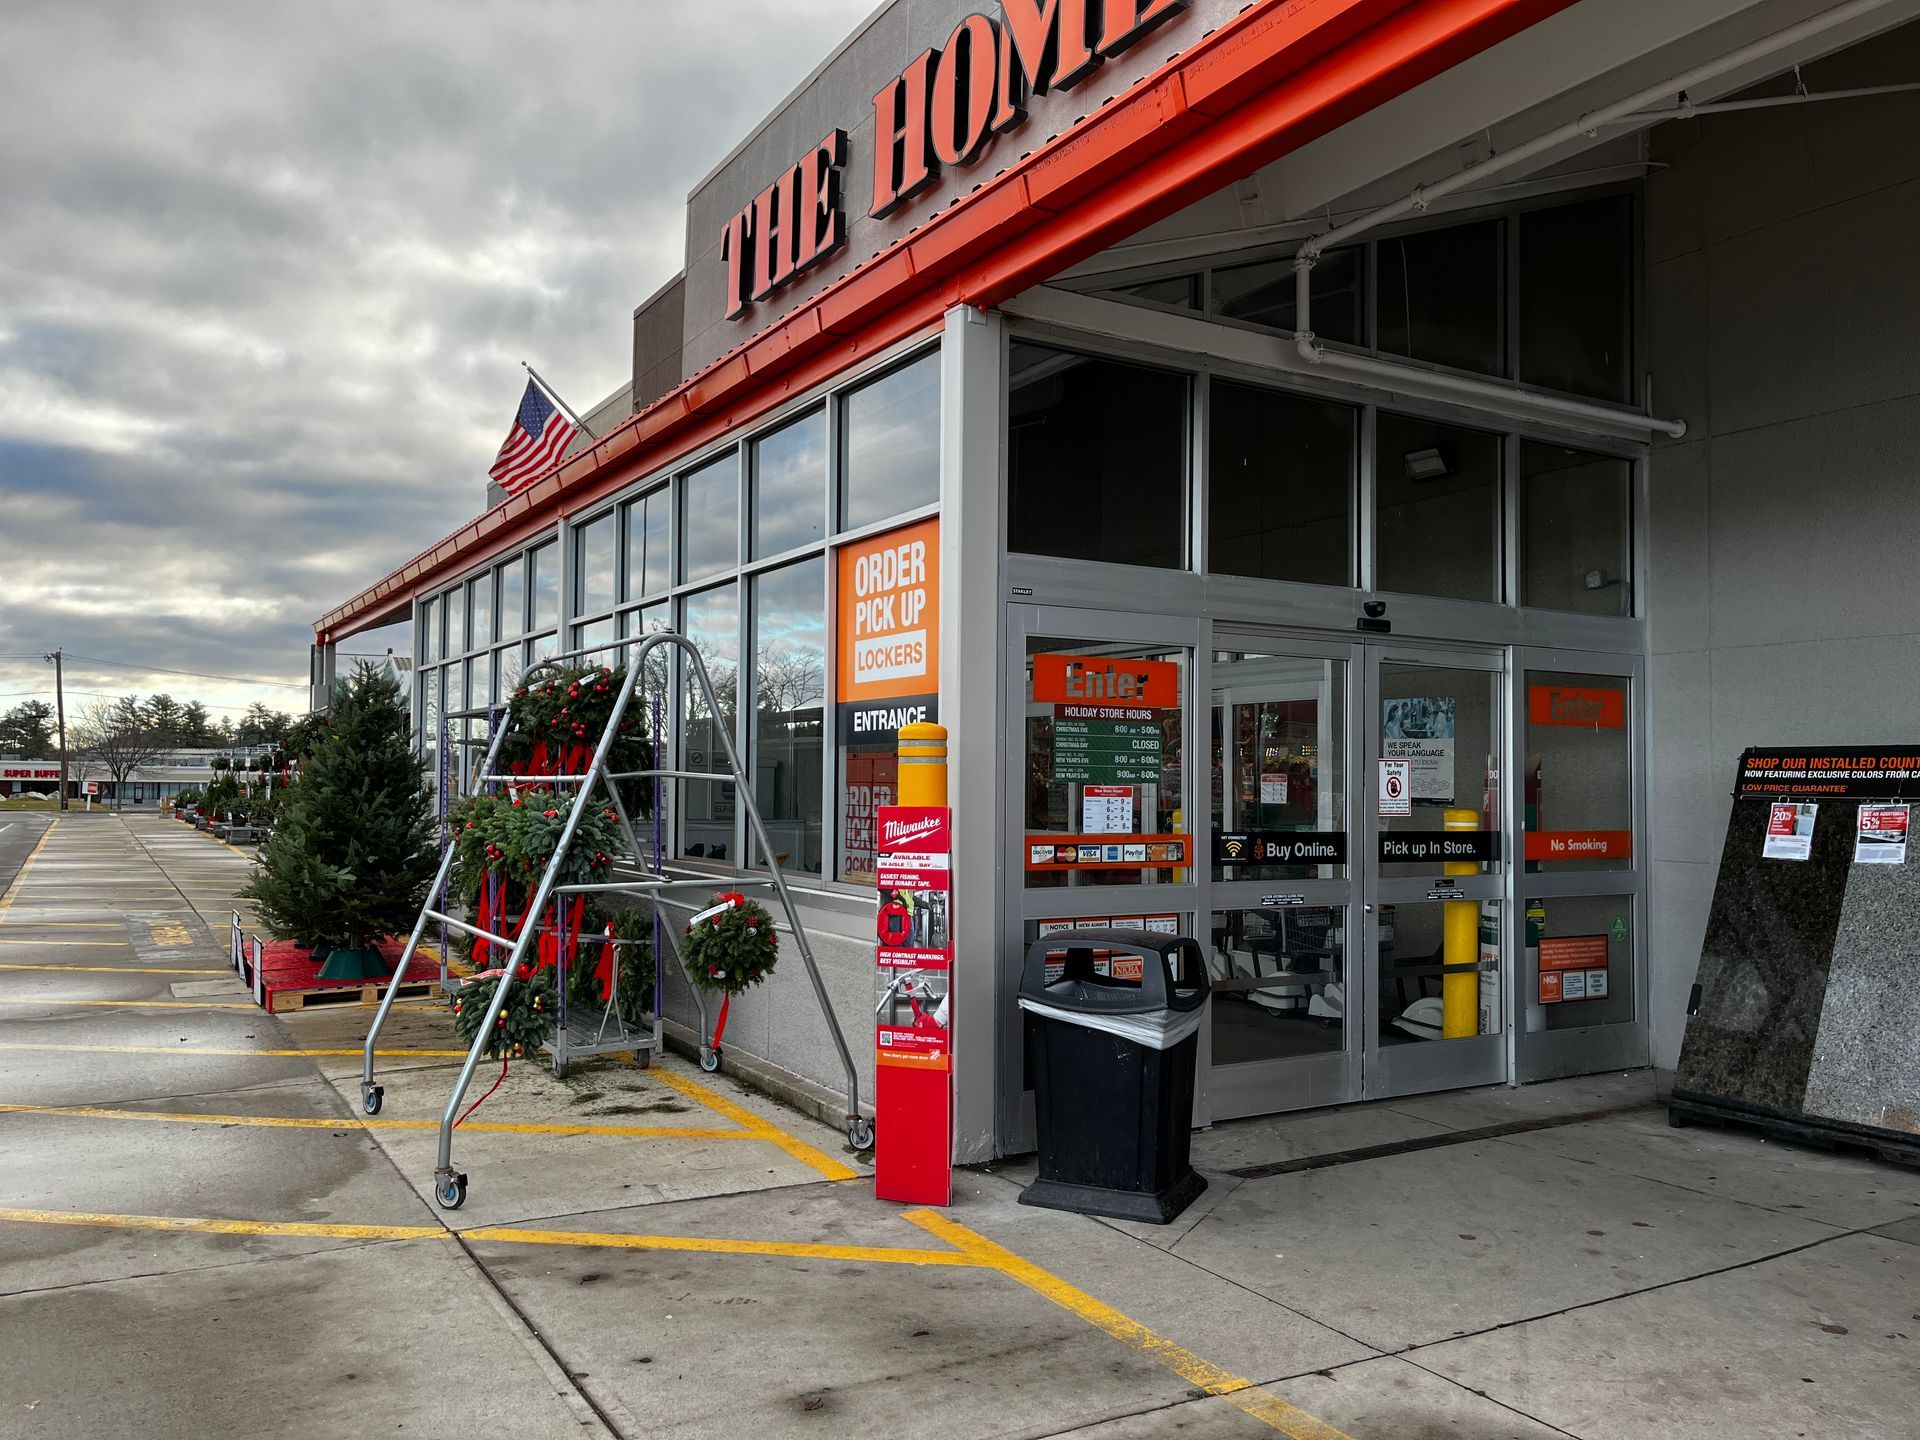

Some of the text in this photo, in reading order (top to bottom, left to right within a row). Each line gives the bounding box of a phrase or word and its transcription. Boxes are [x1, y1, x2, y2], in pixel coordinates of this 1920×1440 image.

[721, 129, 846, 320] THE
[854, 541, 926, 597] ORDER
[855, 588, 926, 635] PICK UP
[858, 641, 923, 671] LOCKERS
[1066, 662, 1149, 700] Enter
[1065, 706, 1152, 720] HOLIDAY STORE HOURS
[1549, 692, 1605, 722] Enter
[854, 705, 926, 732] ENTRANCE
[1132, 739, 1160, 750] CLOSED
[1387, 749, 1445, 757] YOUR LANGUAGE
[1747, 758, 1779, 768] SHOP
[1781, 758, 1806, 768] OUR
[1809, 757, 1876, 768] INSTALLED
[4, 769, 62, 778] SUPER BUFFE
[1386, 769, 1402, 777] Safety
[1764, 770, 1807, 778] FEATURING
[1807, 770, 1850, 779] EXCLUSIVE
[1851, 770, 1884, 779] COLORS
[1885, 770, 1909, 779] FROM
[1763, 784, 1790, 792] PRICE
[1792, 784, 1846, 793] GUARANTEE
[846, 785, 891, 817] RDER
[881, 817, 941, 841] Milwaukee
[1862, 817, 1879, 829] 5%
[846, 818, 871, 848] ICK
[1125, 849, 1143, 857] PayPal
[1267, 842, 1337, 861] Buy Online.
[1384, 841, 1476, 858] Pick up In Store.
[1551, 838, 1607, 853] No Smoking
[1082, 850, 1097, 858] VISA
[1116, 966, 1141, 976] NKBA
